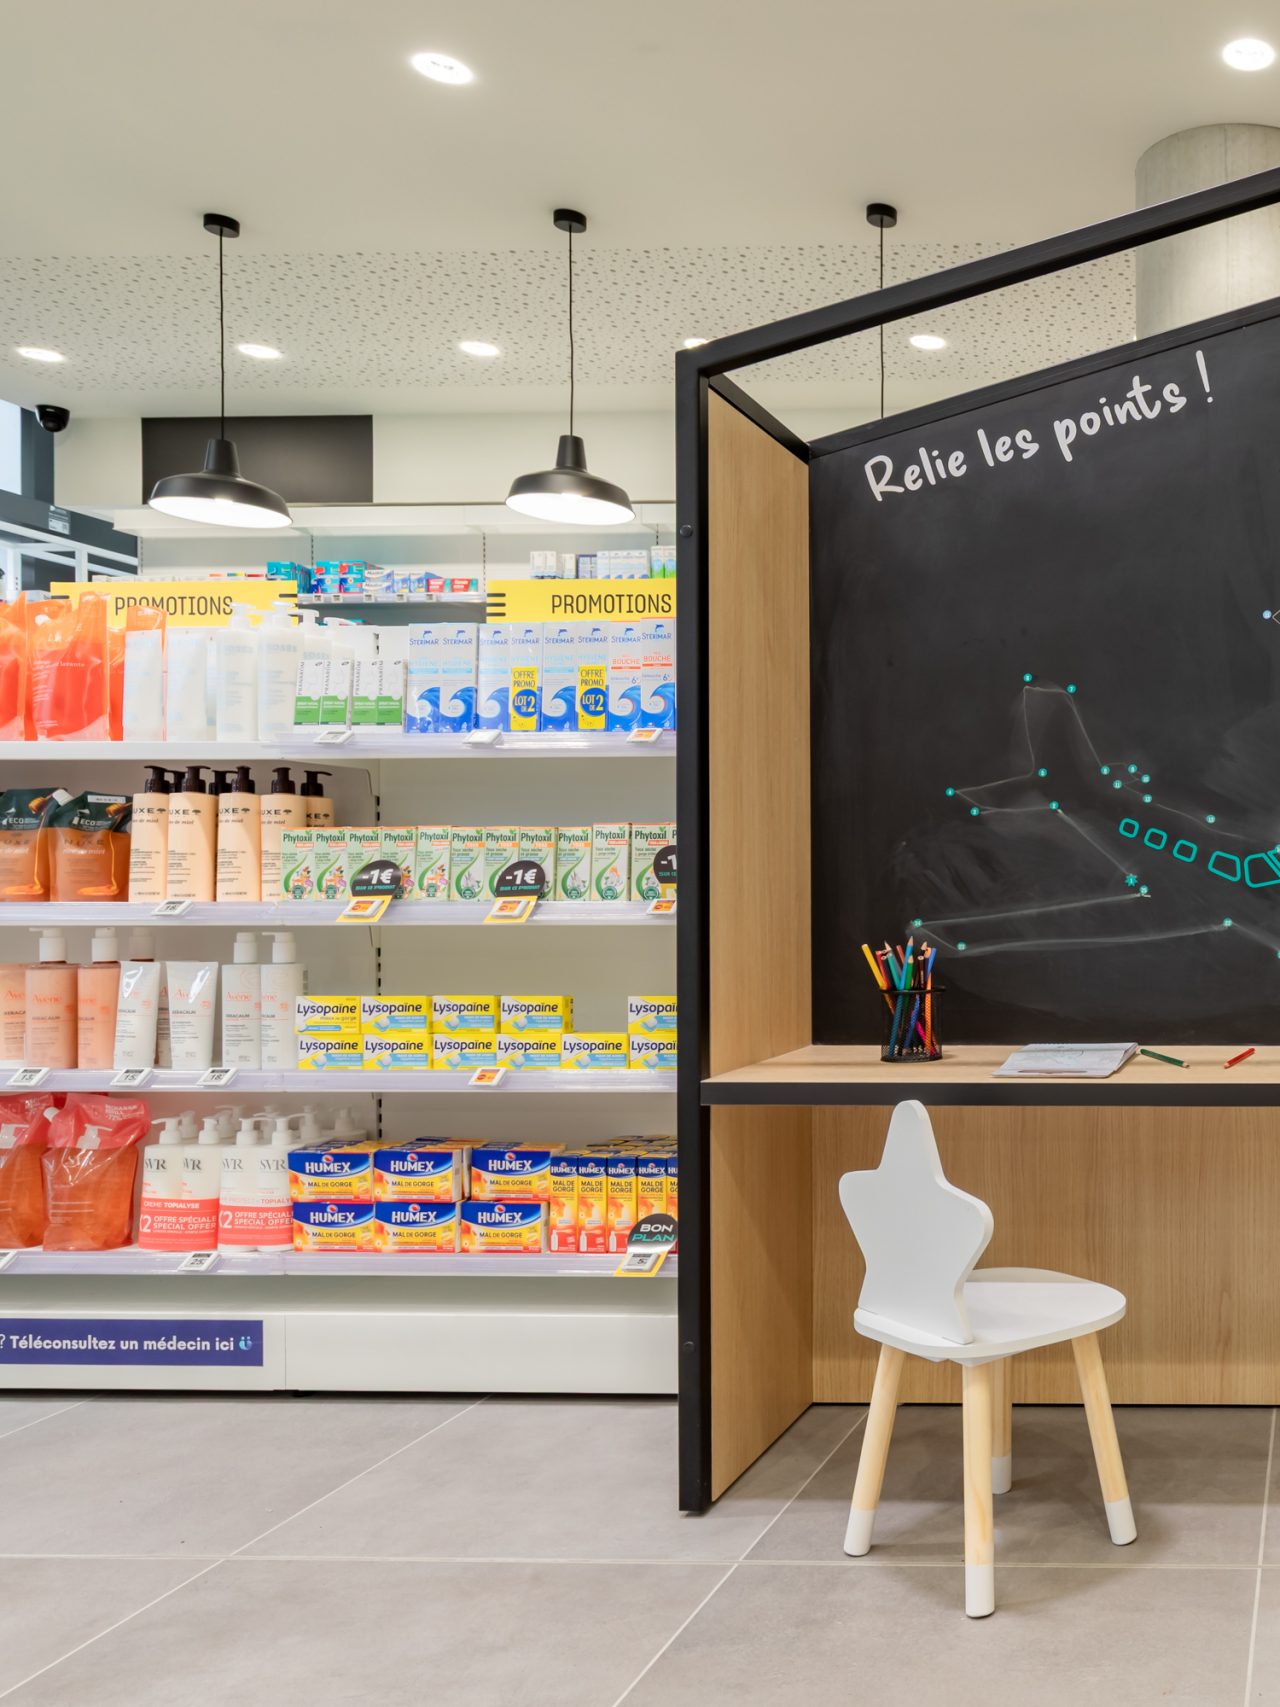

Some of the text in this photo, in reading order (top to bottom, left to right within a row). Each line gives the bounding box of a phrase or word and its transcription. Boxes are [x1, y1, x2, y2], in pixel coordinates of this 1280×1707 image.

[864, 349, 1214, 502] Relie les points !
[551, 593, 672, 614] PROMOTIONS
[513, 671, 534, 679] OFFRE
[580, 669, 603, 678] OFFRE
[513, 680, 536, 688] PROMO
[580, 679, 604, 687] PROMO
[514, 695, 535, 712] LOT 2
[582, 694, 604, 711] LOT 2
[283, 832, 312, 844] Phytoxil
[316, 832, 346, 844] Phytoxil
[349, 832, 379, 844] Phytoxil
[384, 832, 414, 844] Phytoxil
[420, 831, 449, 842] Phytoxil
[452, 832, 483, 844] Phytoxil
[486, 832, 517, 844] Phytoxil
[520, 832, 552, 844] Phytoxil
[558, 832, 589, 844] Phytoxil
[594, 830, 626, 842] Phytoxil
[634, 830, 667, 842] Phytoxil
[361, 868, 394, 885] -1€
[505, 868, 538, 885] -1€
[297, 1003, 357, 1016] Lysopaïne
[362, 1002, 422, 1016] Lysopaïne
[433, 1002, 490, 1015] Lysopaïne
[502, 1002, 558, 1015] Lysopaïne
[300, 1040, 358, 1053] Lysopaïne
[365, 1040, 423, 1053] Lysopaïne
[434, 1040, 492, 1053] Lysopaïne
[498, 1040, 556, 1053] Lysopaïne
[563, 1040, 622, 1053] Lysopaïne
[305, 1162, 350, 1174] HUMEX
[390, 1160, 434, 1172] HUMEX
[488, 1160, 533, 1172] HUMEX
[578, 1166, 606, 1174] HUMEX
[310, 1212, 355, 1224] HUMEX
[392, 1211, 436, 1223] HUMEX
[478, 1212, 523, 1224] HUMEX
[640, 1223, 674, 1232] BON
[632, 1234, 675, 1242] PLAN
[10, 1334, 116, 1350] Téléconsultez
[120, 1338, 138, 1350] un
[143, 1335, 211, 1350] médecin
[216, 1337, 234, 1350] ici
